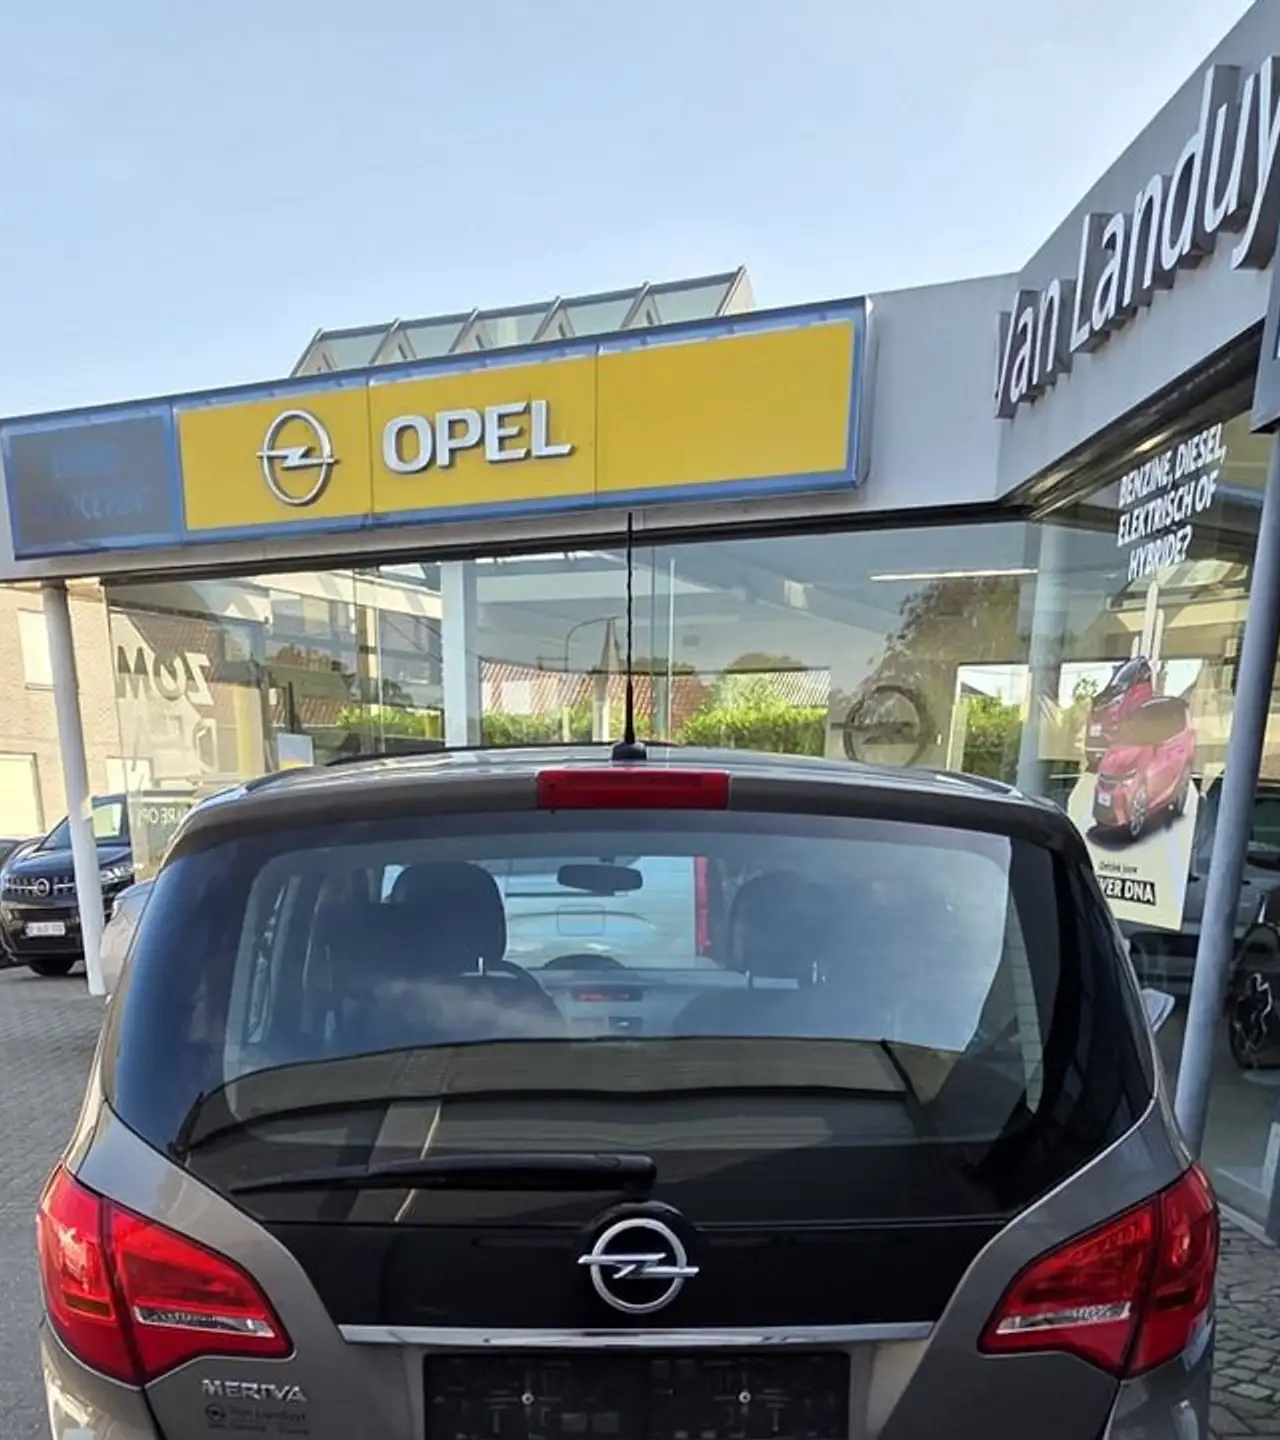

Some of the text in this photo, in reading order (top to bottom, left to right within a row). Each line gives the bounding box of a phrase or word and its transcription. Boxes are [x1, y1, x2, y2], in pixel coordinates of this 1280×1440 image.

[994, 278, 1066, 412] Van
[383, 399, 574, 473] OPEL
[1118, 422, 1227, 508] BENZINE, DIESEL,
[1117, 468, 1219, 547] ELEKTRISCH OF
[1127, 524, 1192, 582] HYBRIDE?
[1124, 880, 1154, 903] DNA
[201, 1379, 308, 1402] MERIVA
